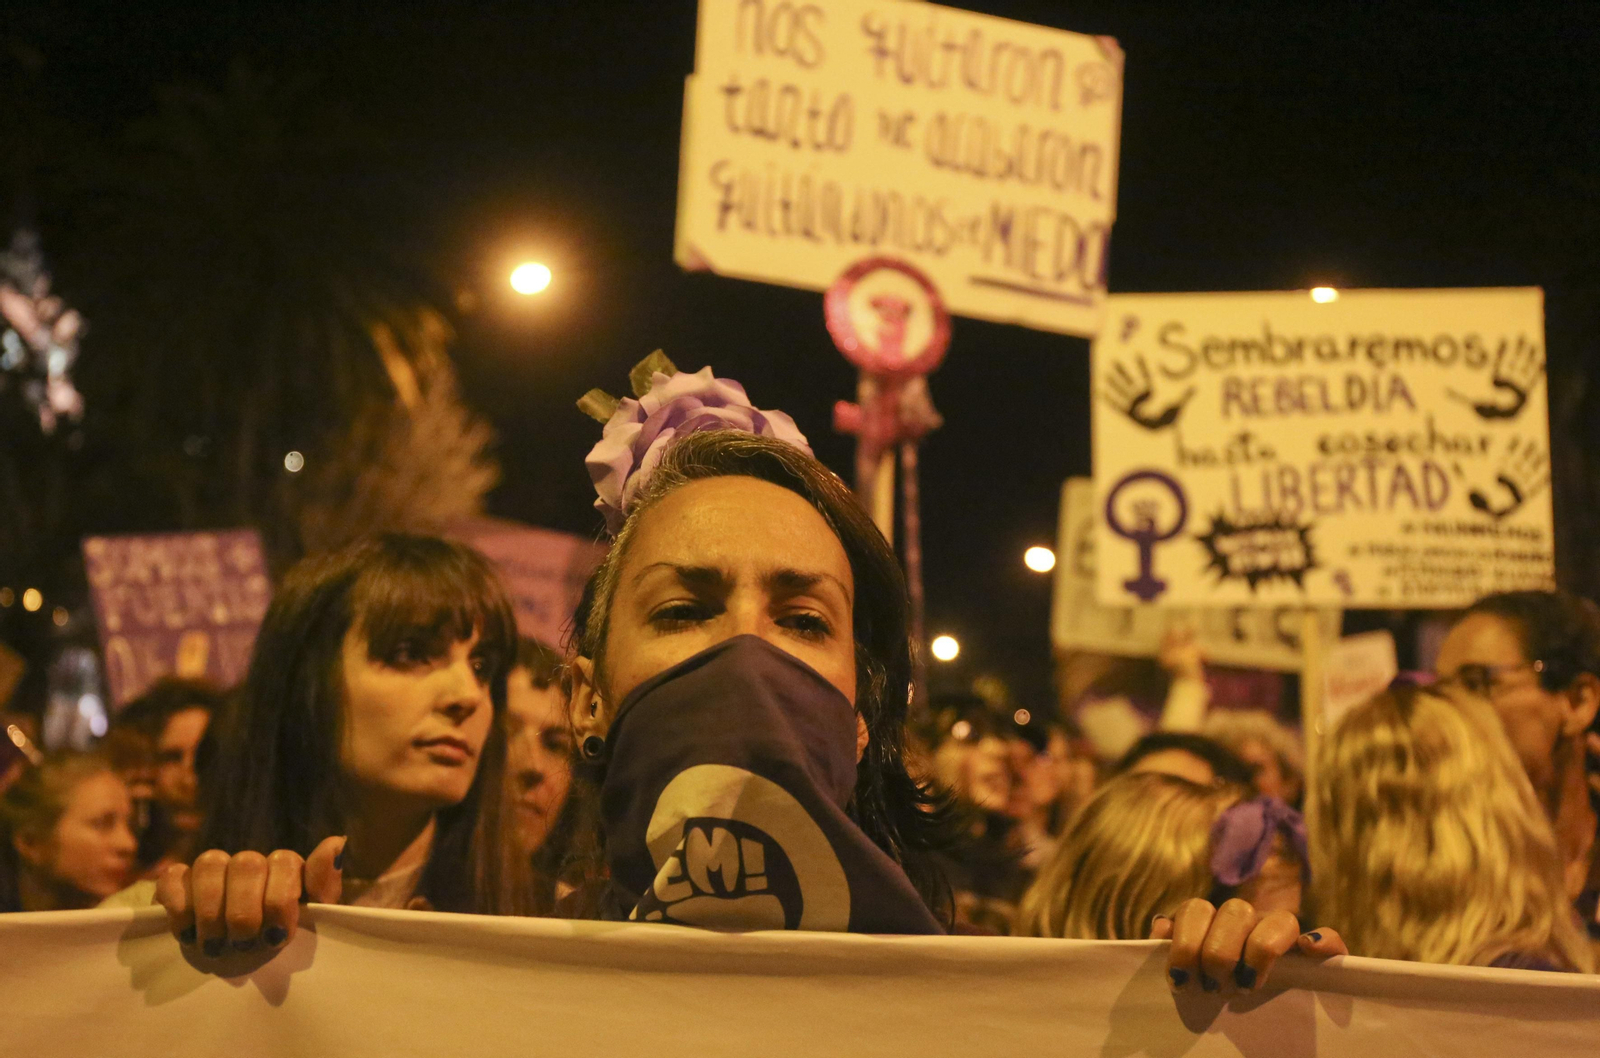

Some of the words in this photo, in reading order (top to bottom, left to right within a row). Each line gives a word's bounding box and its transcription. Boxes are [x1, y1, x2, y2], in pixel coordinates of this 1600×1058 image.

[721, 78, 854, 153] tanto
[981, 200, 1110, 291] MIEDO
[1157, 317, 1489, 381] Sembraremos
[1317, 414, 1490, 456] cosechar
[1231, 460, 1451, 521] LIBERTAD
